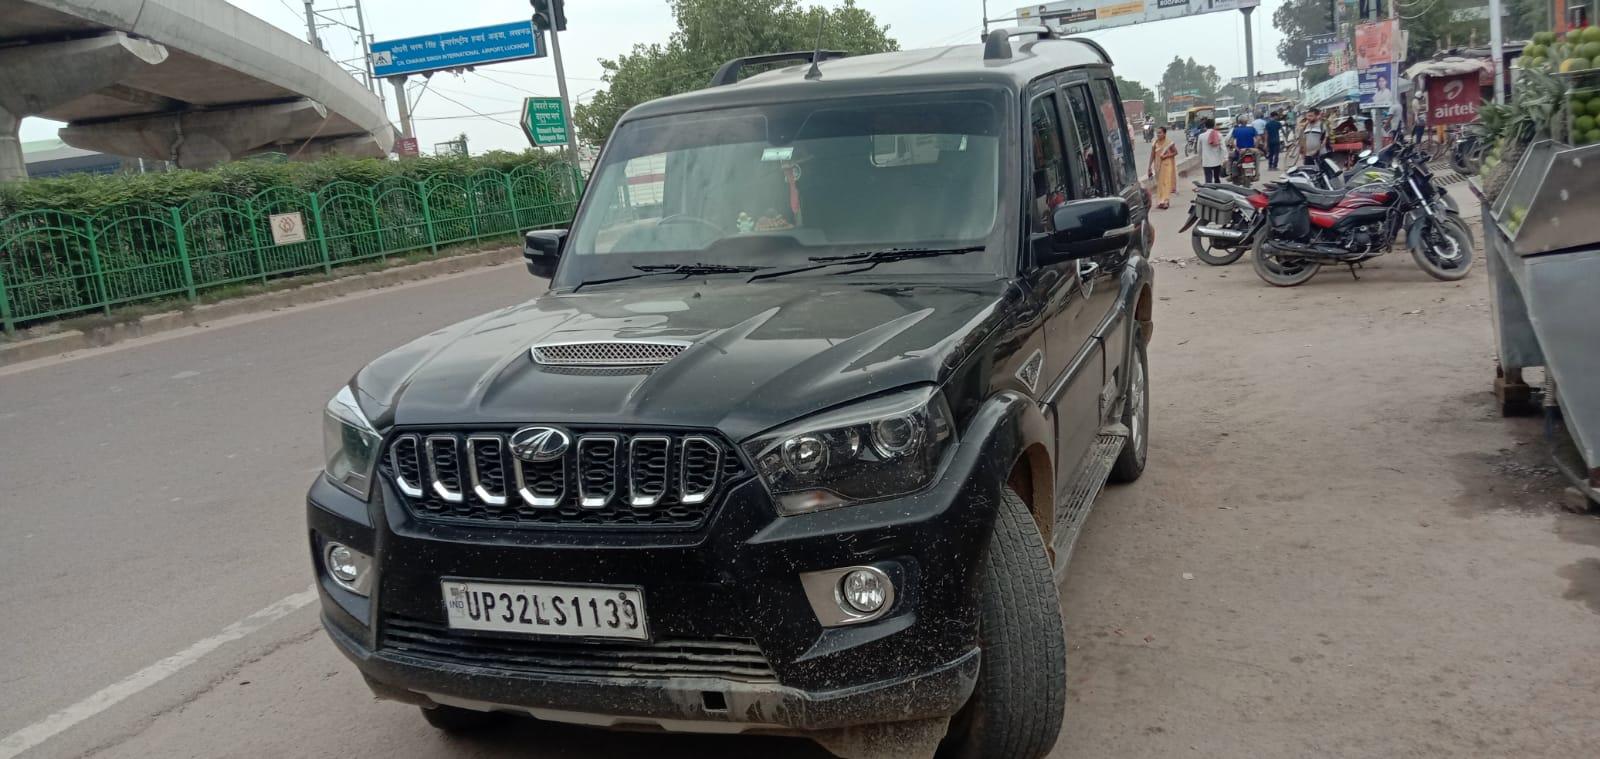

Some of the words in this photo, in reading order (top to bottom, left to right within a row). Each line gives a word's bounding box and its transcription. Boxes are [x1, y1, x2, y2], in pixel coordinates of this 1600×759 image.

[441, 49, 480, 59] INTERNATIONAL
[1434, 102, 1475, 119] airtel
[465, 590, 639, 630] UP32LS1139
